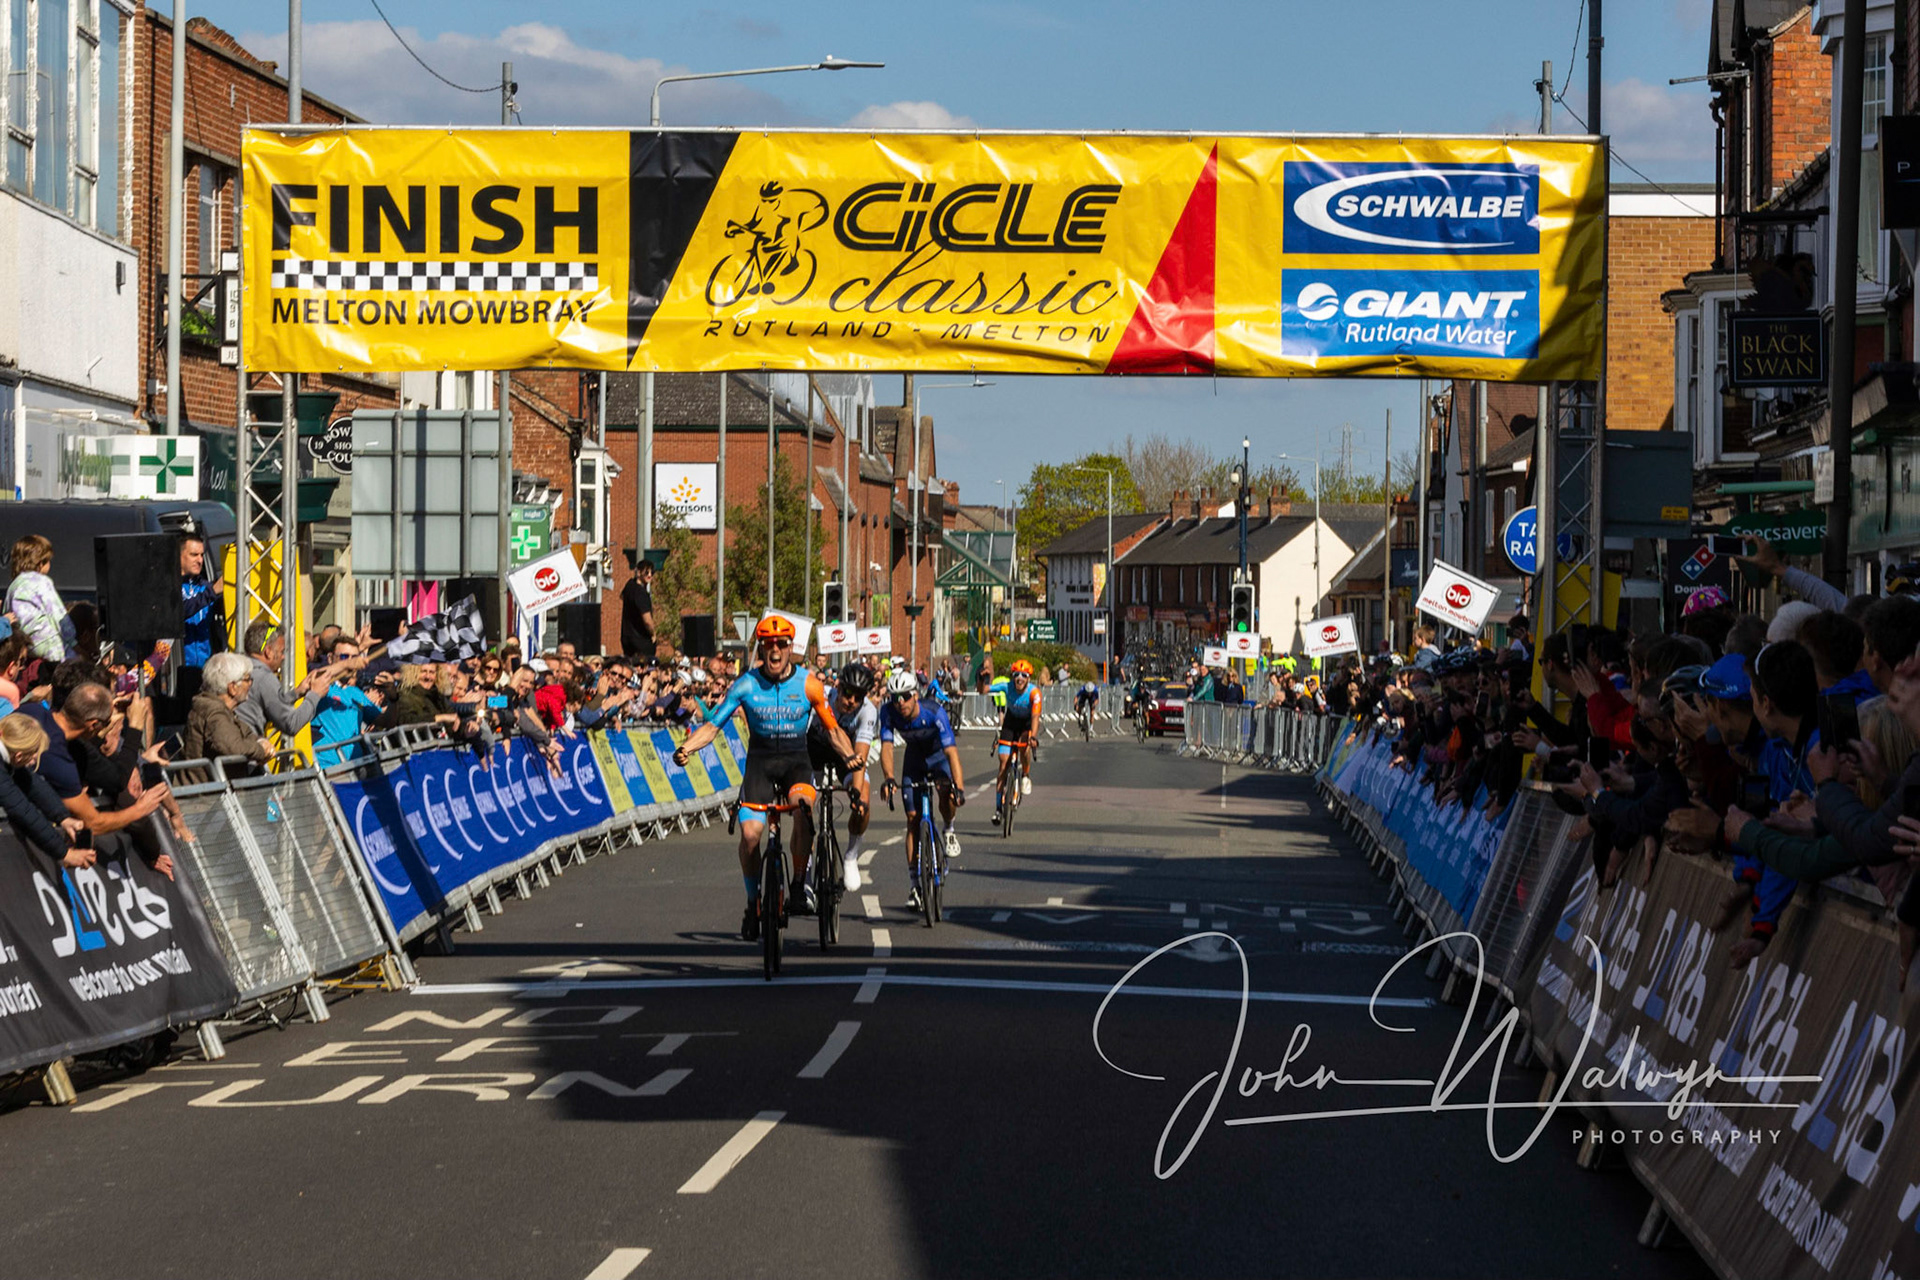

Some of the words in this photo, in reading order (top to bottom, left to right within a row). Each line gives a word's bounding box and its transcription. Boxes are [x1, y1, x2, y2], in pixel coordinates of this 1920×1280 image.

[1336, 194, 1525, 219] SCHWALBE
[271, 184, 598, 254] FINISH
[827, 236, 1118, 315] classic
[271, 297, 406, 325] MELTON
[418, 298, 596, 325] MOWBRAY
[1343, 290, 1526, 319] GIANT
[704, 320, 891, 339] RUTLAND
[942, 323, 1110, 344] MELTON
[1344, 321, 1437, 344] Rutland
[1442, 322, 1516, 344] Water
[1769, 324, 1788, 334] THE
[1741, 334, 1815, 354] BLACK
[1743, 356, 1815, 377] SWAN
[323, 426, 352, 444] BOW
[1446, 586, 1471, 607] bid
[364, 1005, 644, 1033] NO
[72, 1066, 694, 1114] TURN
